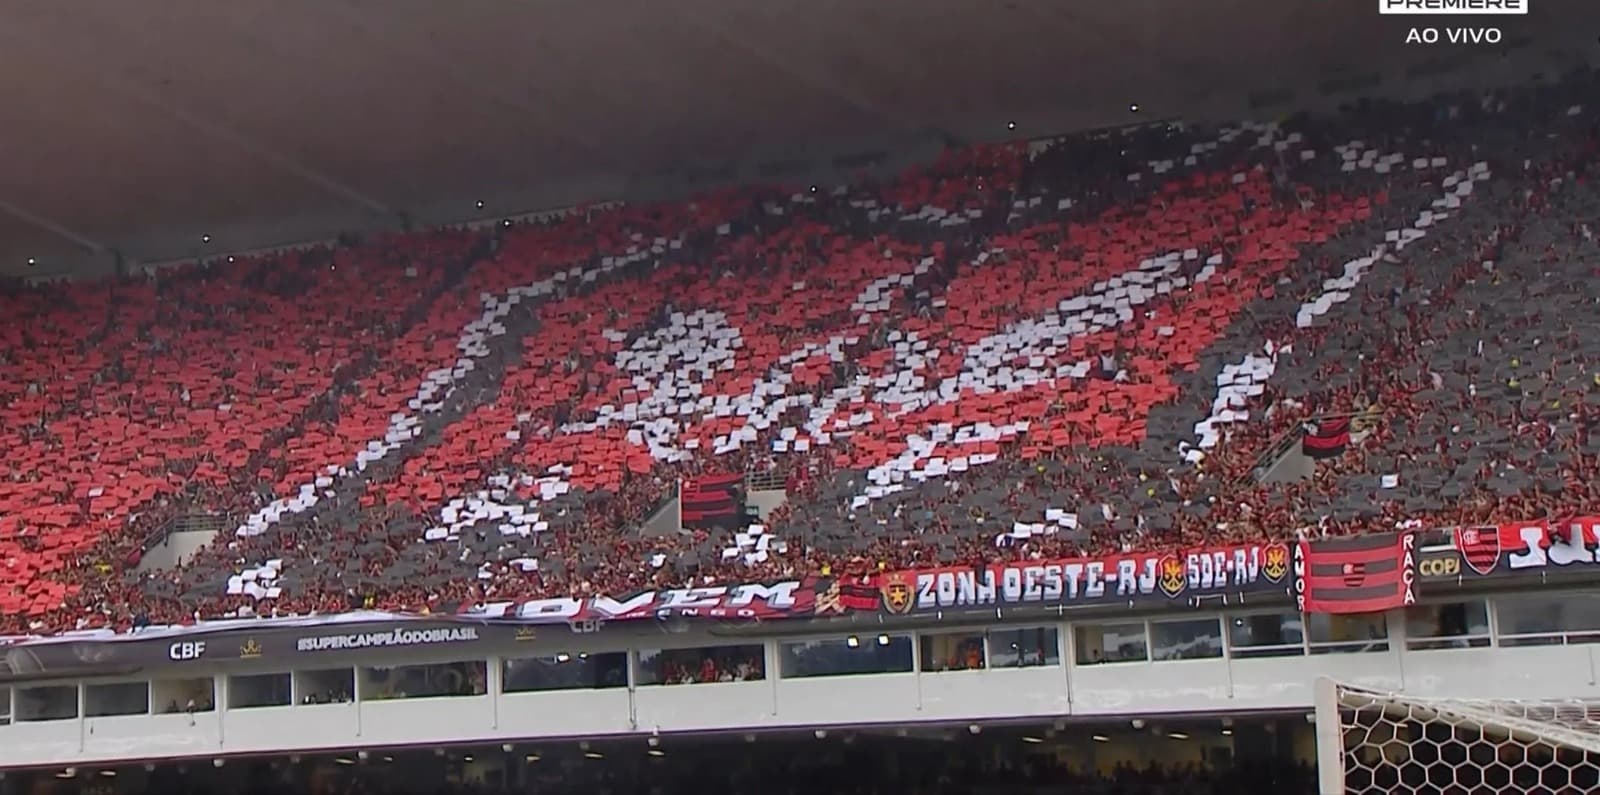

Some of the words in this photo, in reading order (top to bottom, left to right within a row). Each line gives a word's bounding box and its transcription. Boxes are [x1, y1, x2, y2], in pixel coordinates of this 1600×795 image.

[917, 570, 997, 609] ZONA
[1002, 558, 1159, 602] OESTE-RJ
[1294, 544, 1306, 611] AMOR
[467, 581, 801, 619] JOVEM
[169, 641, 207, 661] CBF
[297, 627, 479, 651] #SUPERCAMPEÃODOBRASIL
